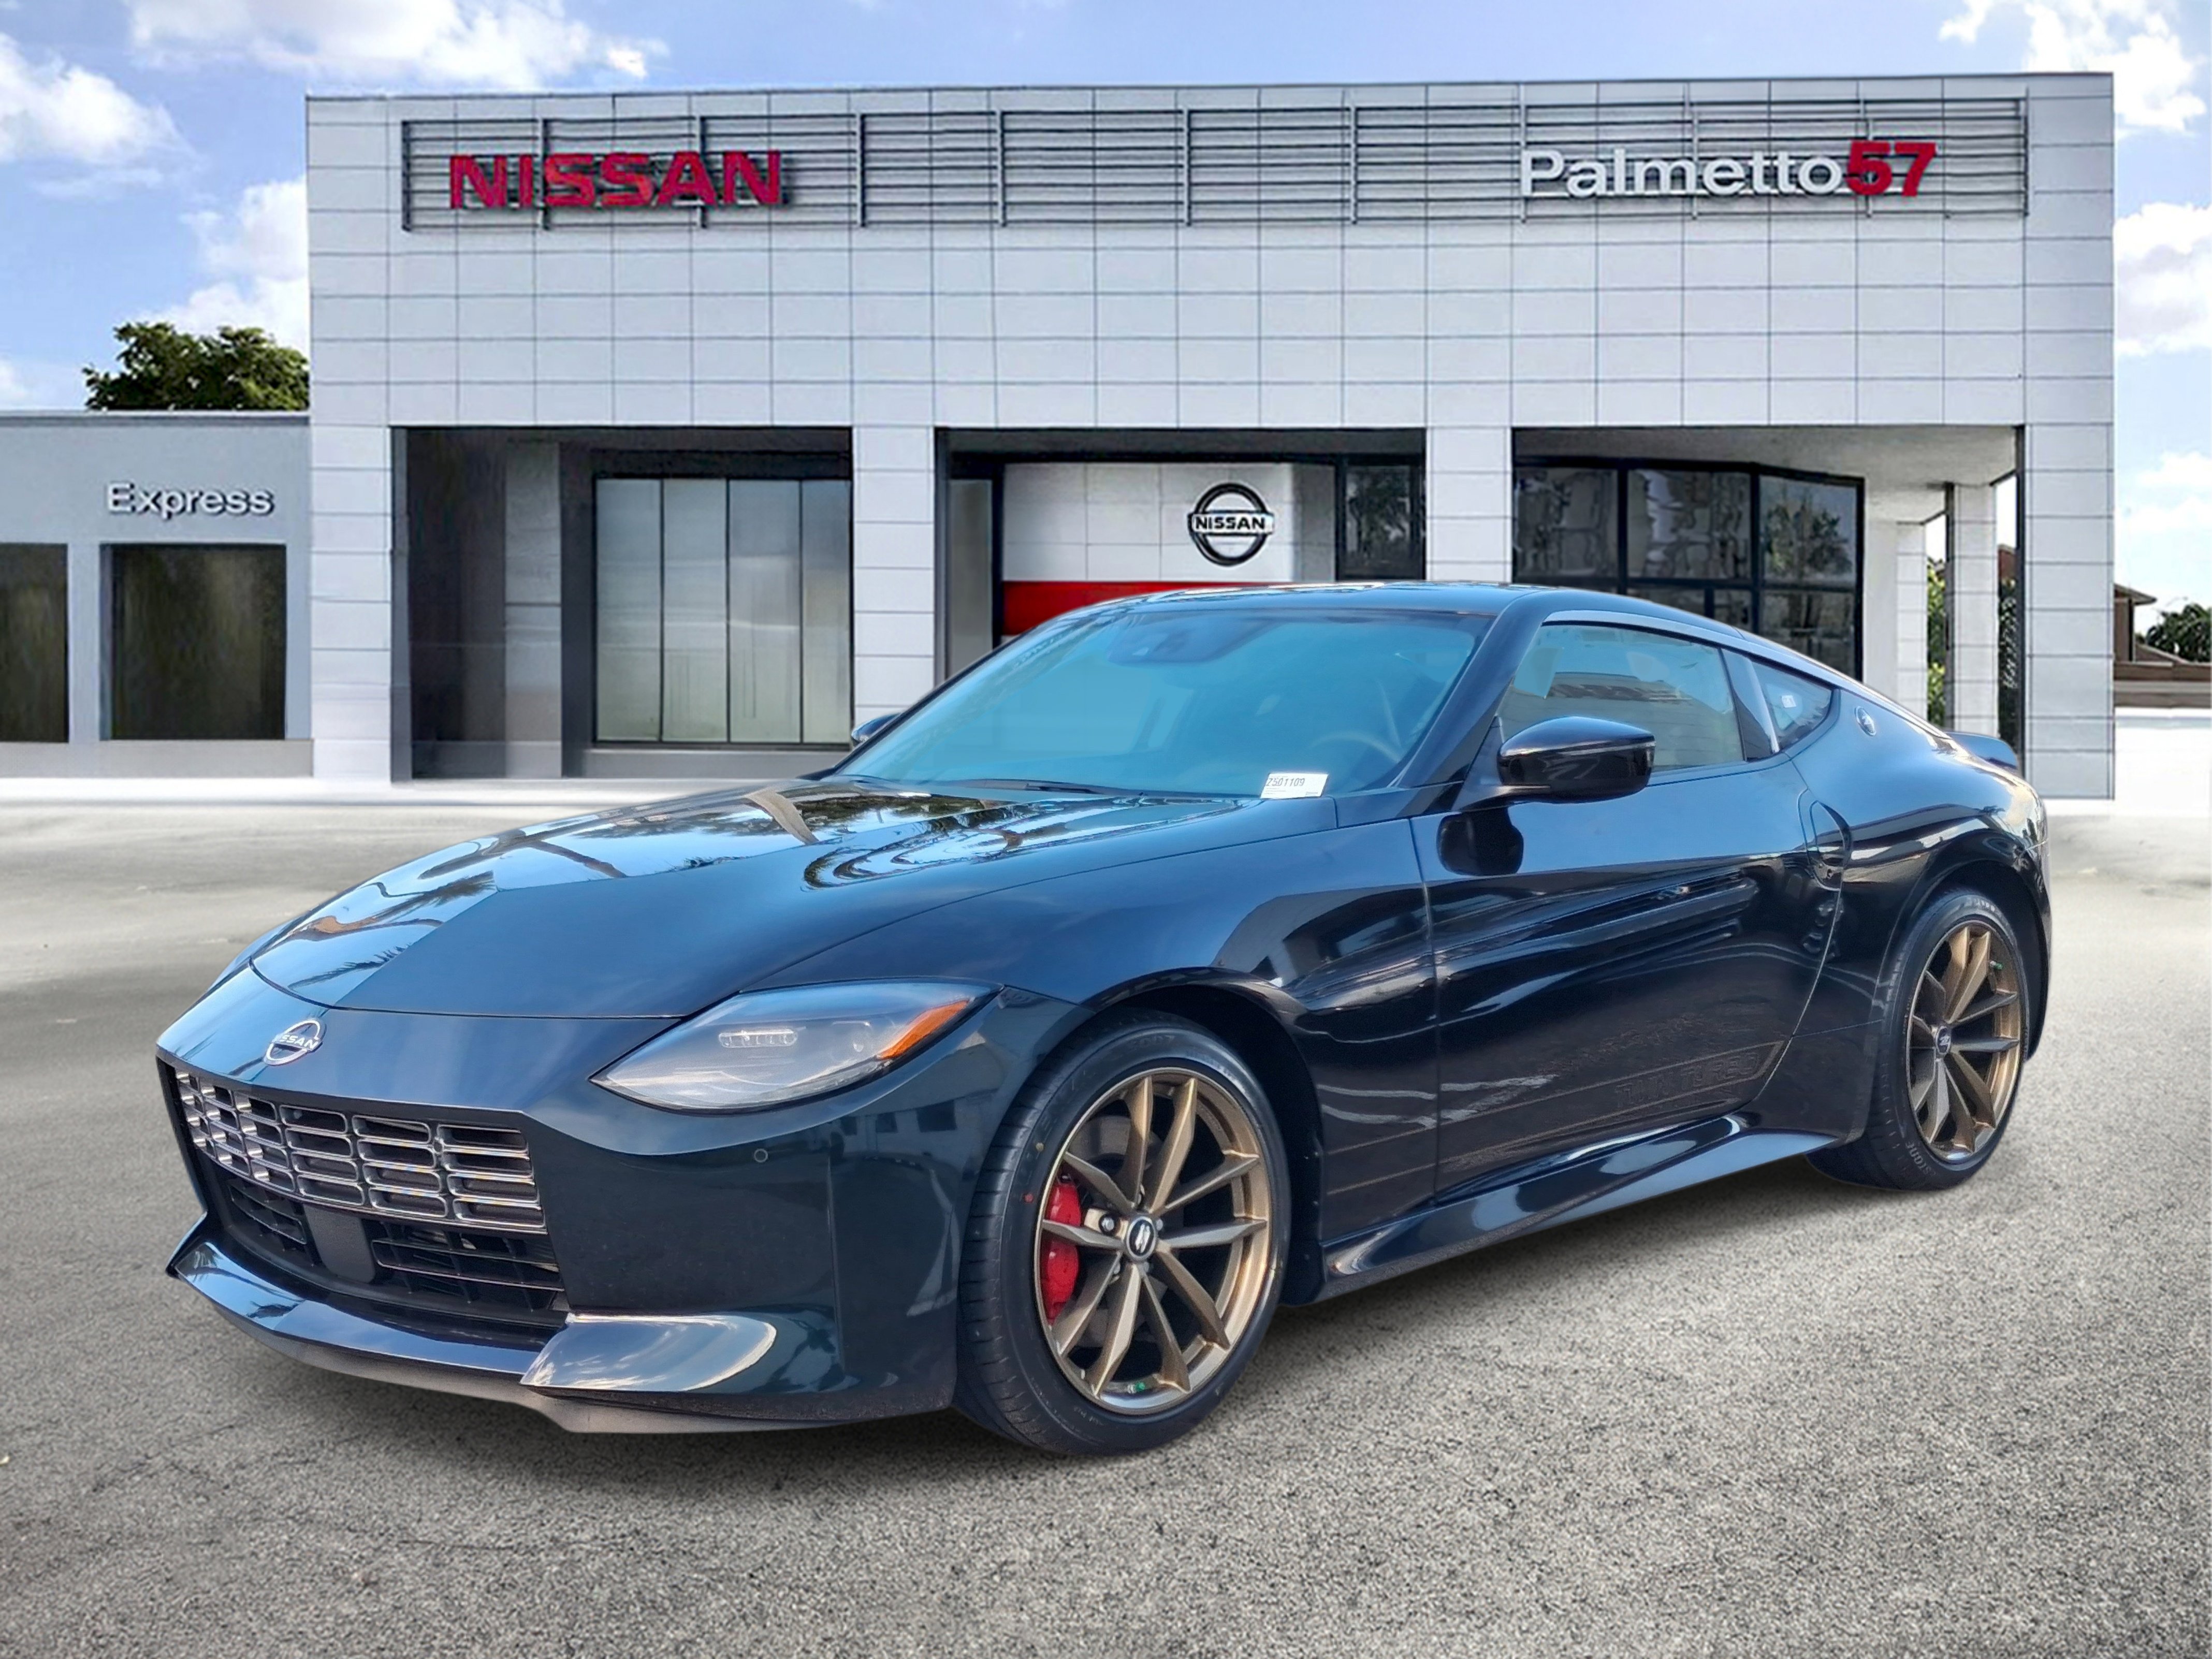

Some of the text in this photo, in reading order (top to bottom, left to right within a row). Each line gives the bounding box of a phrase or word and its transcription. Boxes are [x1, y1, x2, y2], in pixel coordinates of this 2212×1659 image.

[449, 150, 781, 208] NISSAN
[108, 483, 274, 520] Express
[1196, 517, 1265, 530] NISSAN
